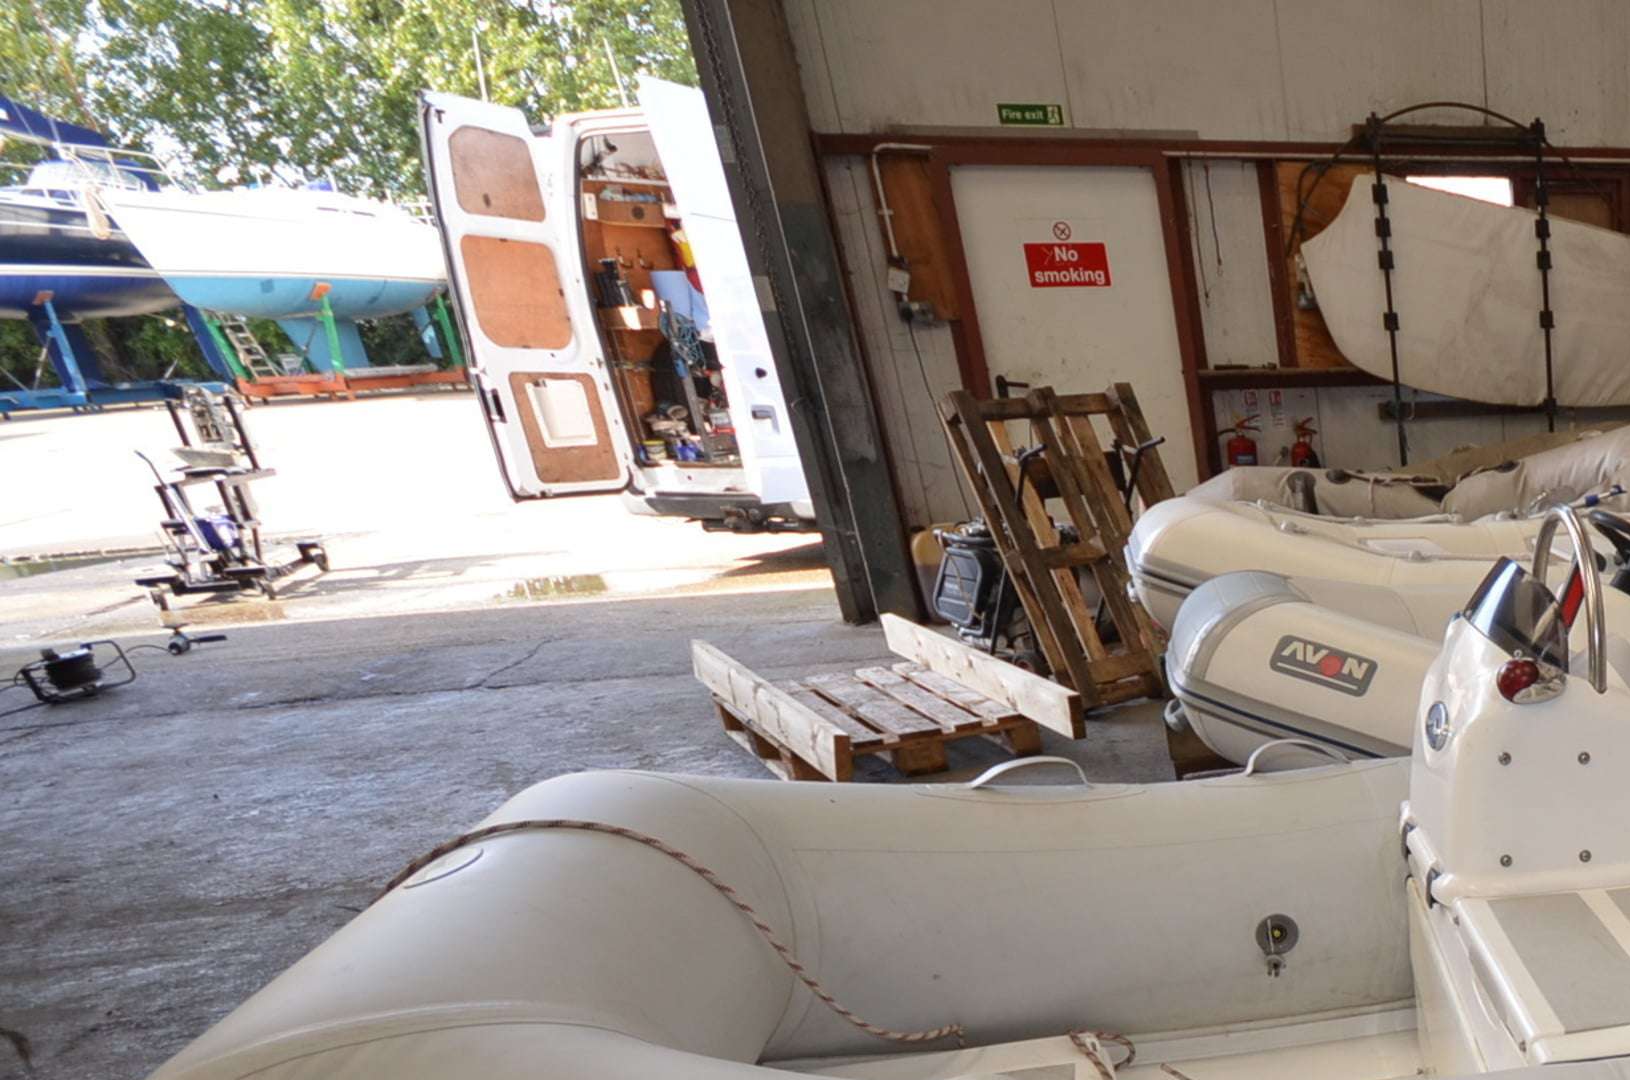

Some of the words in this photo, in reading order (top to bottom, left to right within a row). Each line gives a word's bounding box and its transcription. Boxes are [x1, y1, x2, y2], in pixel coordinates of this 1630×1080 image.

[1001, 108, 1022, 120] Fire
[1024, 109, 1044, 120] exit
[1053, 245, 1078, 262] No
[1034, 266, 1105, 286] smoking
[1281, 640, 1369, 680] AVON
